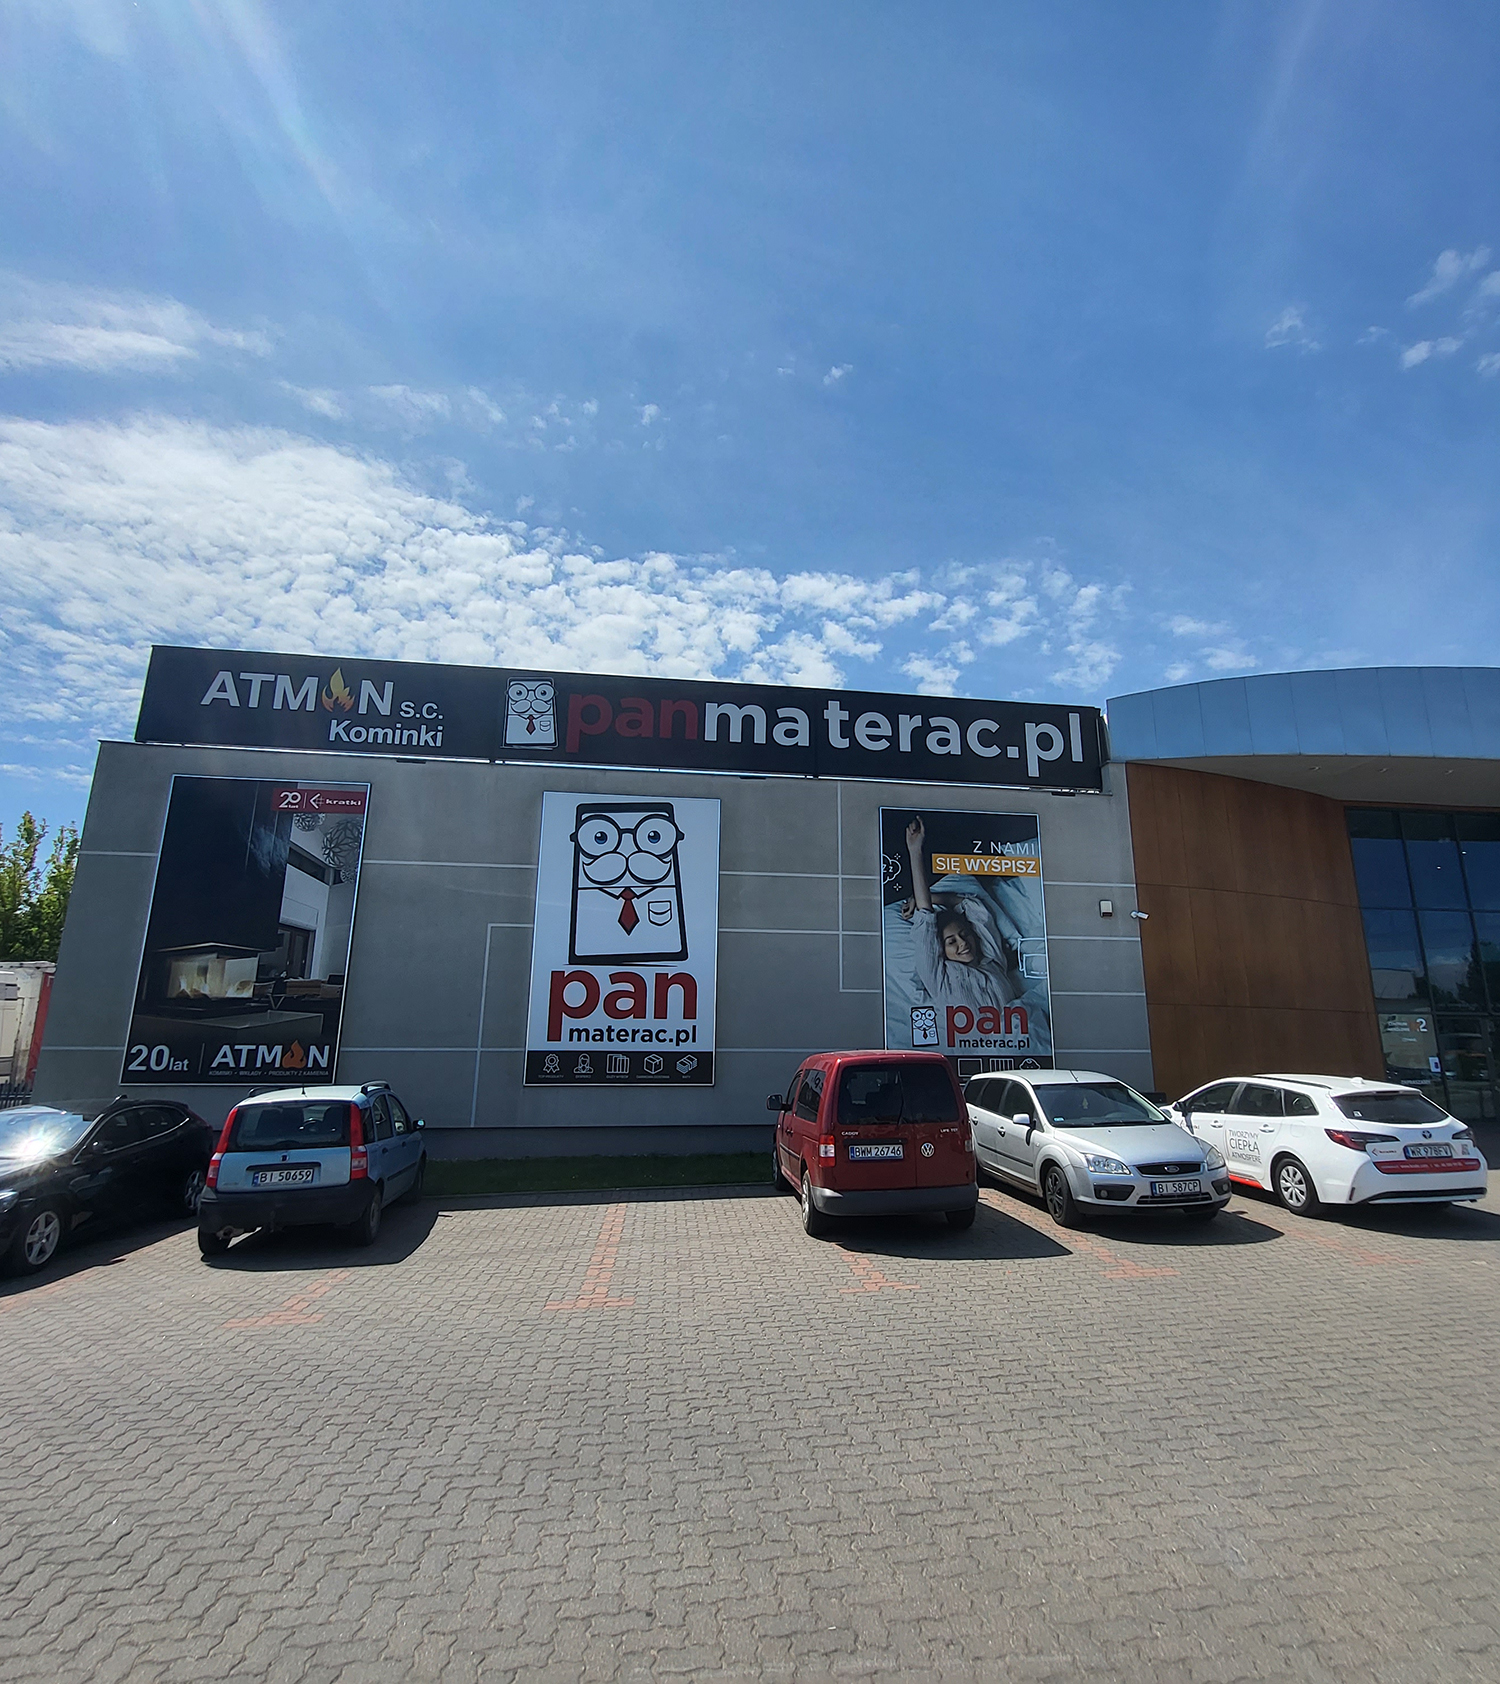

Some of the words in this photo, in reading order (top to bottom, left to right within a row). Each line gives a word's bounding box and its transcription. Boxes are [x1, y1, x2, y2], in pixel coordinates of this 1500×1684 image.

[399, 701, 443, 719] s.c.
[329, 720, 443, 747] Kominki
[325, 798, 361, 806] kratki
[972, 840, 983, 854] Z
[990, 841, 1035, 856] NAMI
[936, 857, 960, 874] SIĘ
[964, 856, 1037, 874] WYŚPISZ
[546, 969, 698, 1042] pan
[945, 1005, 1029, 1048] pan
[568, 1025, 697, 1047] materac.pl
[959, 1037, 1030, 1051] materac.pl
[1228, 1129, 1259, 1140] TWORZYMY
[855, 1147, 873, 1157] BWM
[874, 1146, 902, 1157] 26746
[1229, 1138, 1261, 1156] CIEPŁĄ
[259, 1172, 274, 1183] BI
[278, 1170, 312, 1182] 50659
[1157, 1183, 1169, 1193] BI
[1172, 1181, 1198, 1193] 587CP
